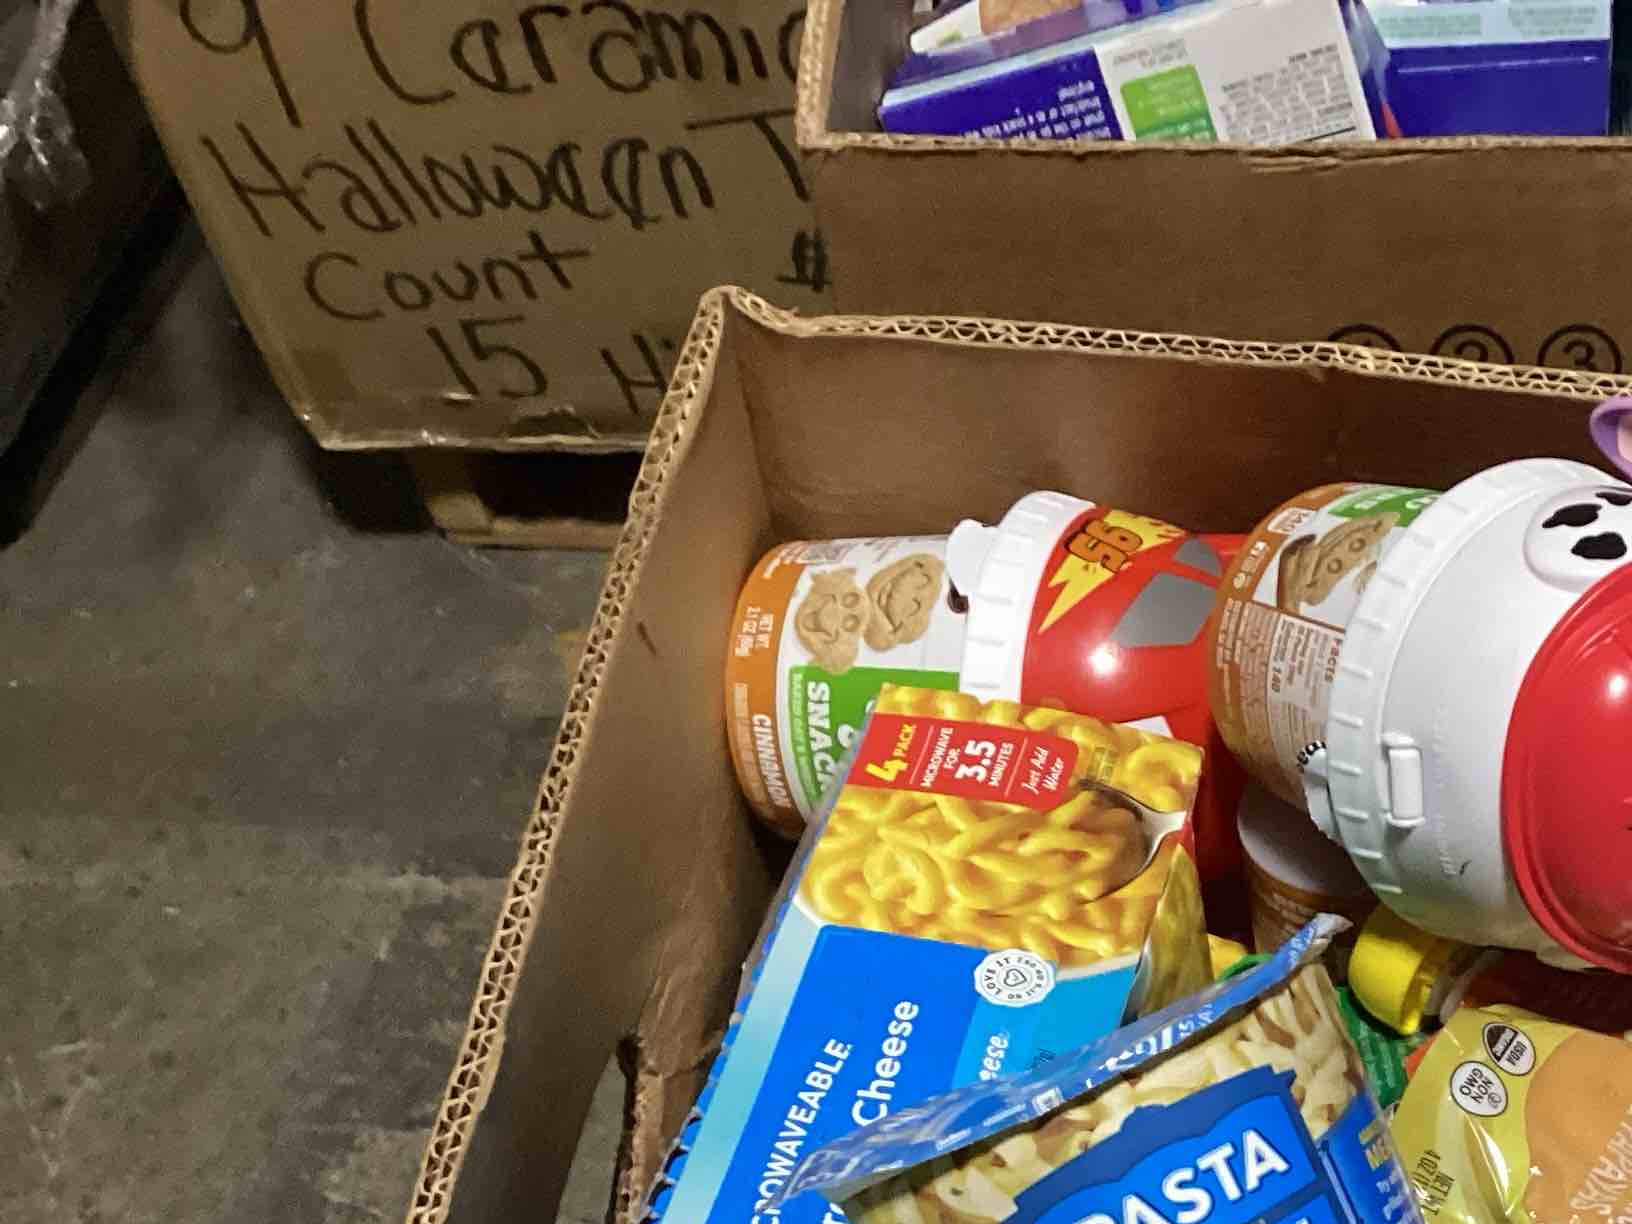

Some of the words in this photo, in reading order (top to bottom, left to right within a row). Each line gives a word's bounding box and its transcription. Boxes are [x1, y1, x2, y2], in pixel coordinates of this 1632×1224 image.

[304, 230, 591, 320] Count
[865, 756, 910, 783] 4
[893, 723, 916, 759] PACK
[919, 726, 955, 788] MICROWAVE
[954, 739, 997, 785] 3.5
[988, 742, 1015, 788] MINUTES
[851, 1000, 920, 1127] Cheese
[1458, 1067, 1484, 1097] GMO
[1471, 1077, 1495, 1105] NON
